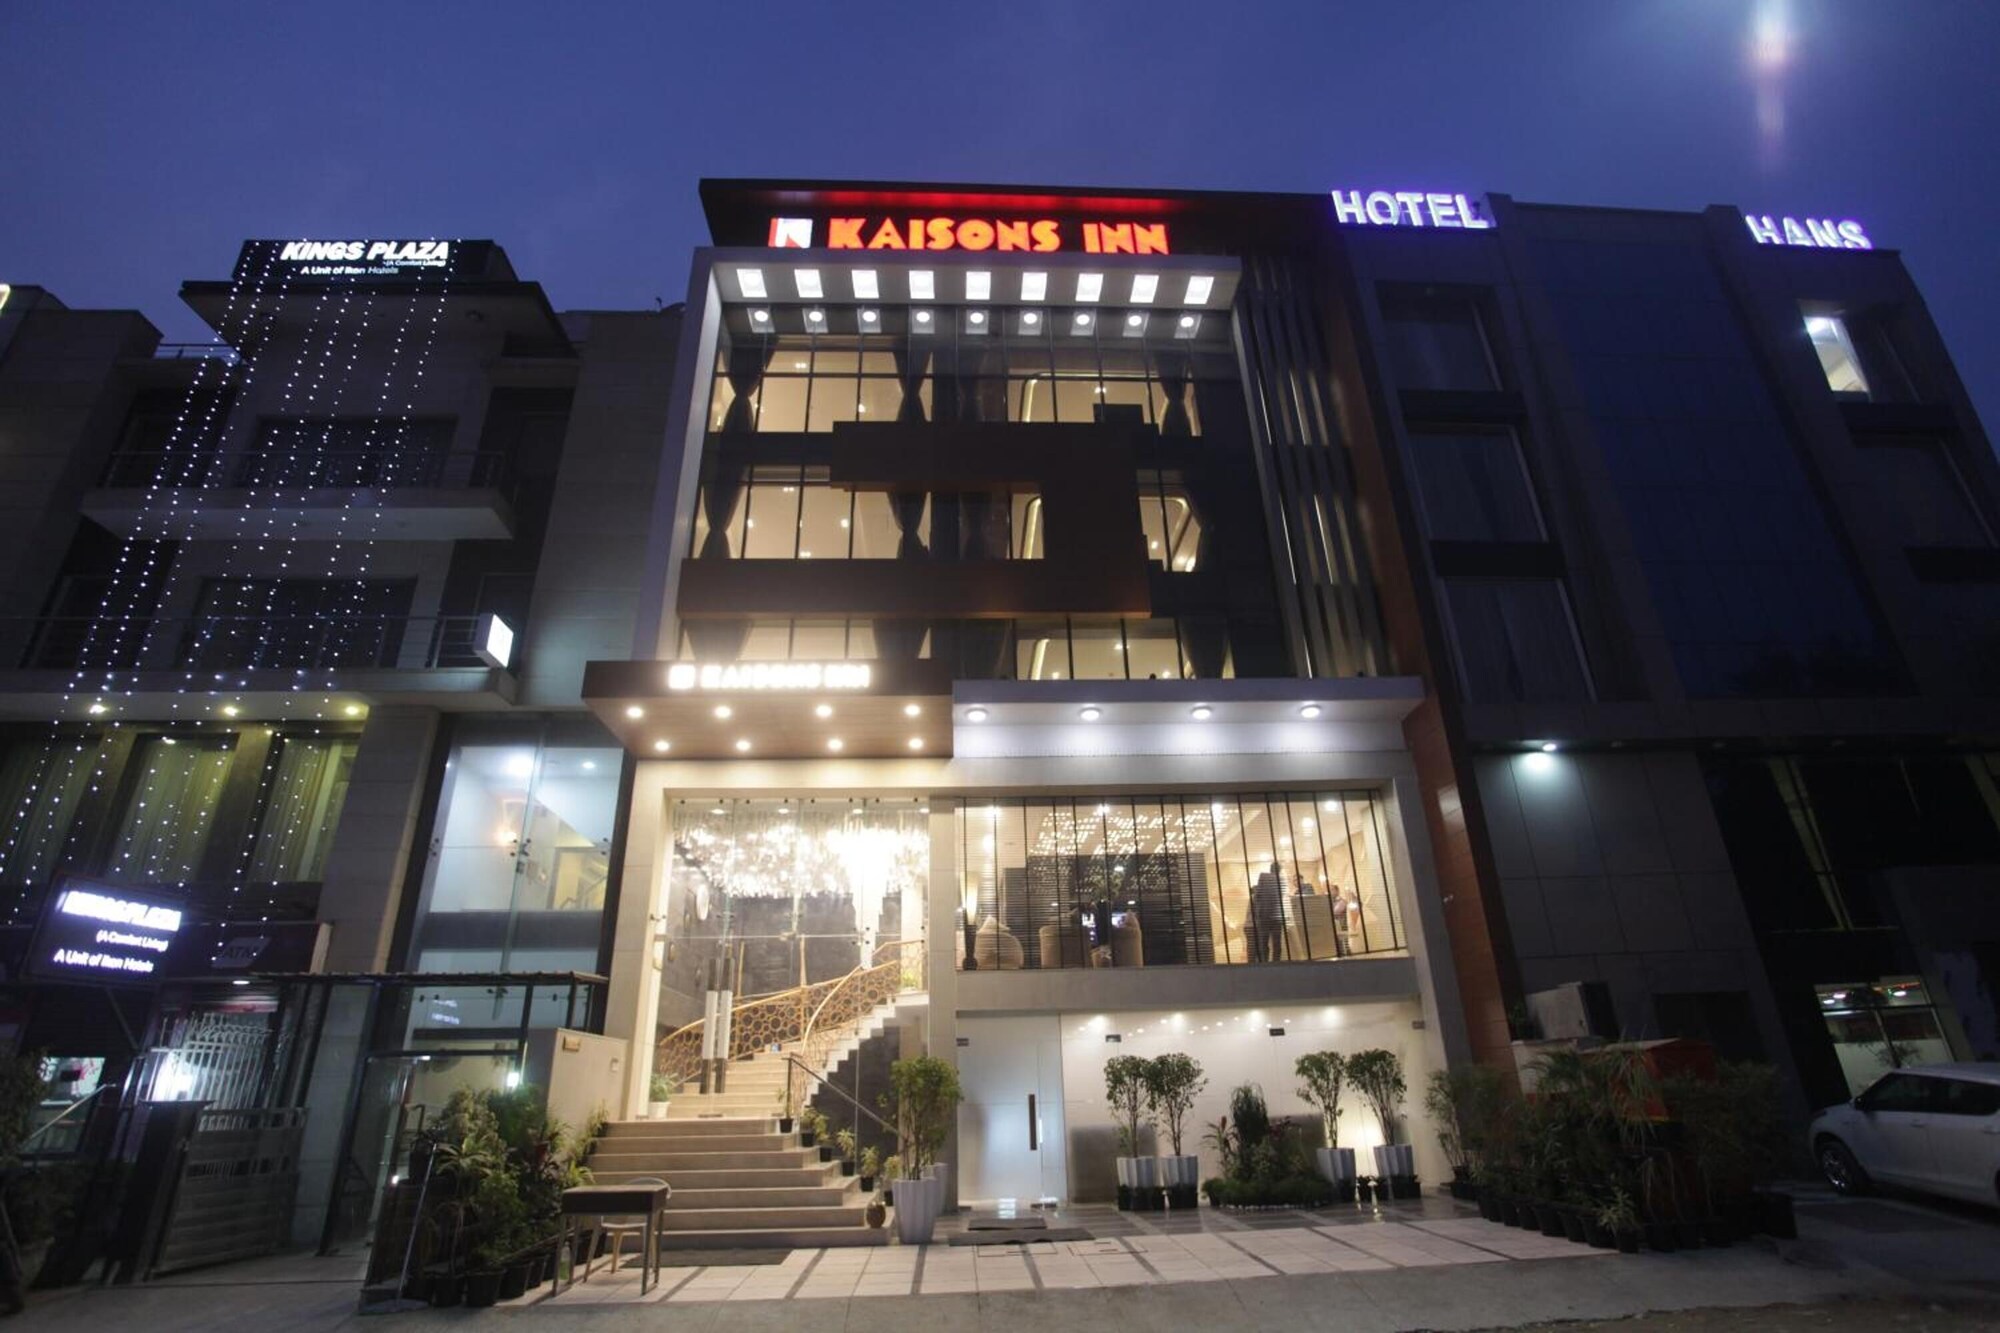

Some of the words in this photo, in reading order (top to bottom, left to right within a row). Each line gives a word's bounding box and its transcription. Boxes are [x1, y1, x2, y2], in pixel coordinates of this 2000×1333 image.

[1332, 190, 1490, 229] HOTEL
[1745, 214, 1872, 250] HANS
[828, 216, 1061, 252] KAISONS
[1082, 222, 1170, 255] INN
[280, 241, 366, 260] KINGS
[367, 241, 448, 260] PLAZA
[300, 265, 309, 275] A
[311, 265, 331, 275] Unit
[332, 265, 345, 275] of
[53, 948, 65, 963] A
